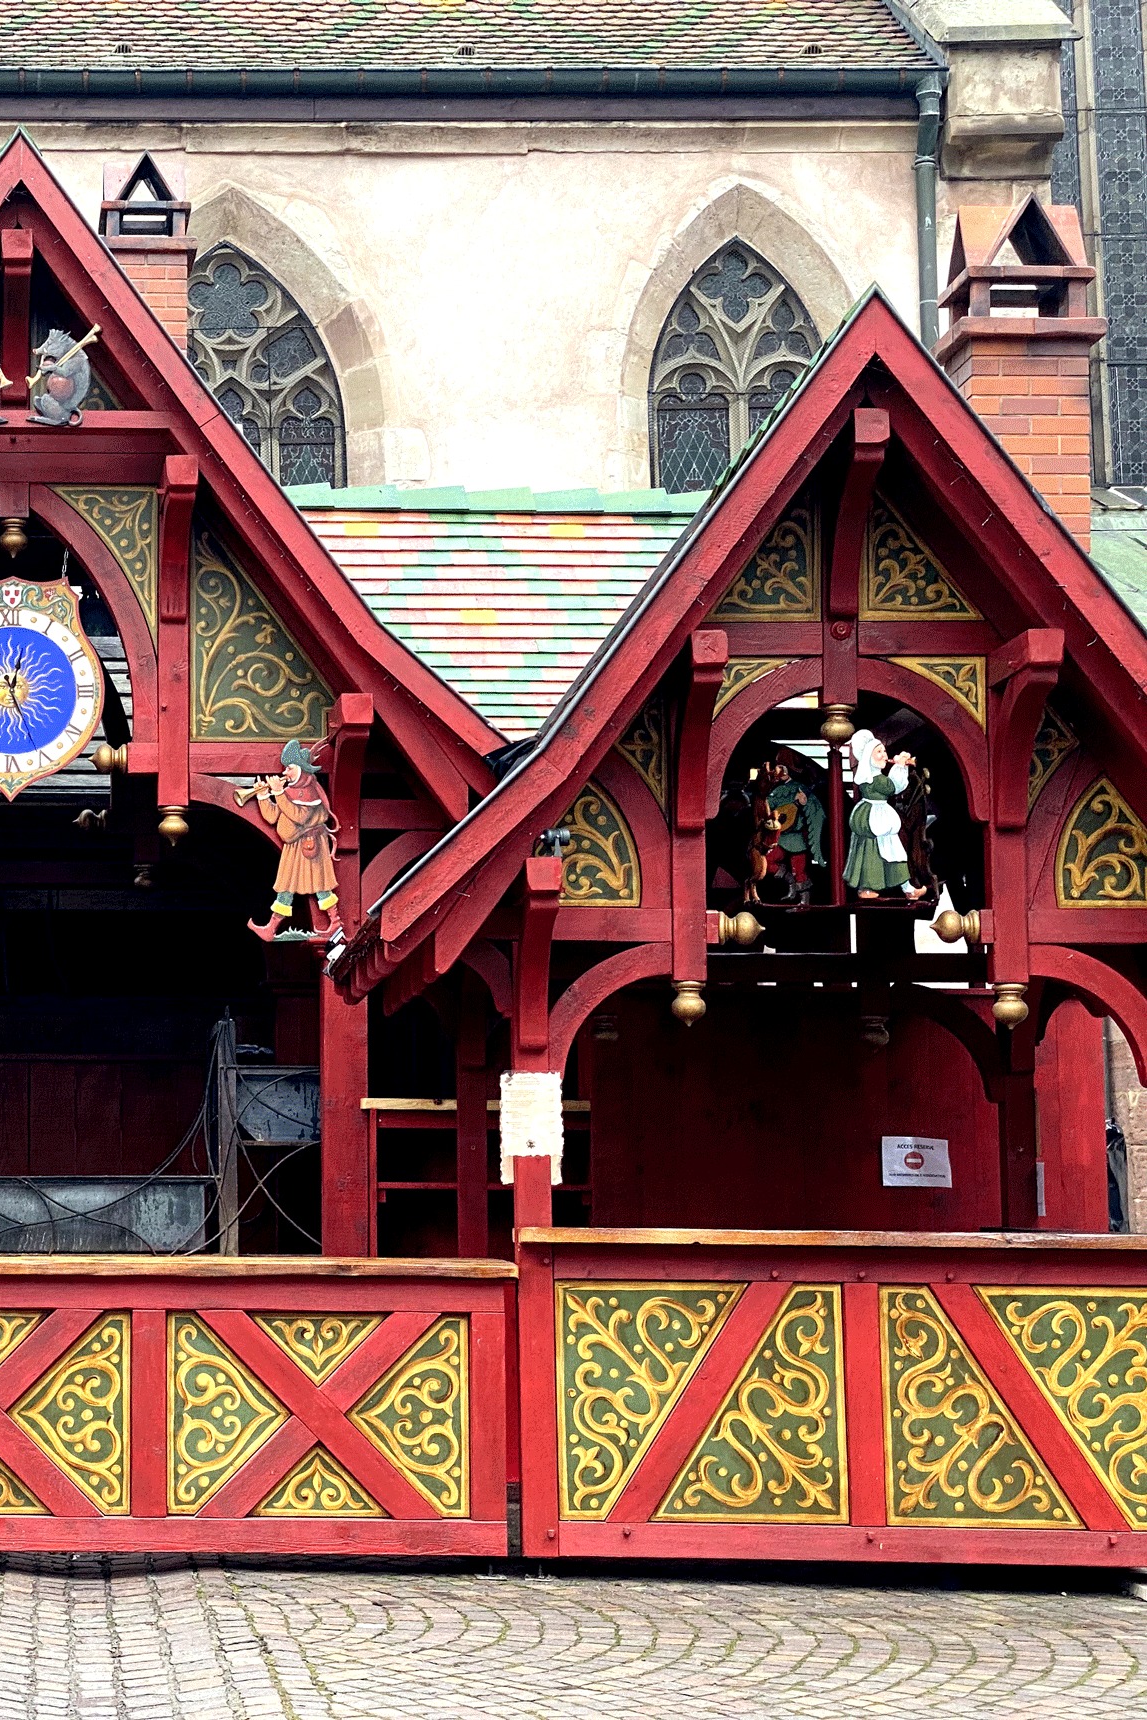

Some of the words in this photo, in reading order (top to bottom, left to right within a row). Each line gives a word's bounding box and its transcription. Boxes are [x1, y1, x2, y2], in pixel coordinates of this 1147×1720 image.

[0, 609, 22, 627] XII
[67, 647, 86, 665] II
[78, 683, 94, 699] III
[65, 722, 83, 745] IV
[4, 755, 21, 773] VI
[38, 750, 54, 768] V
